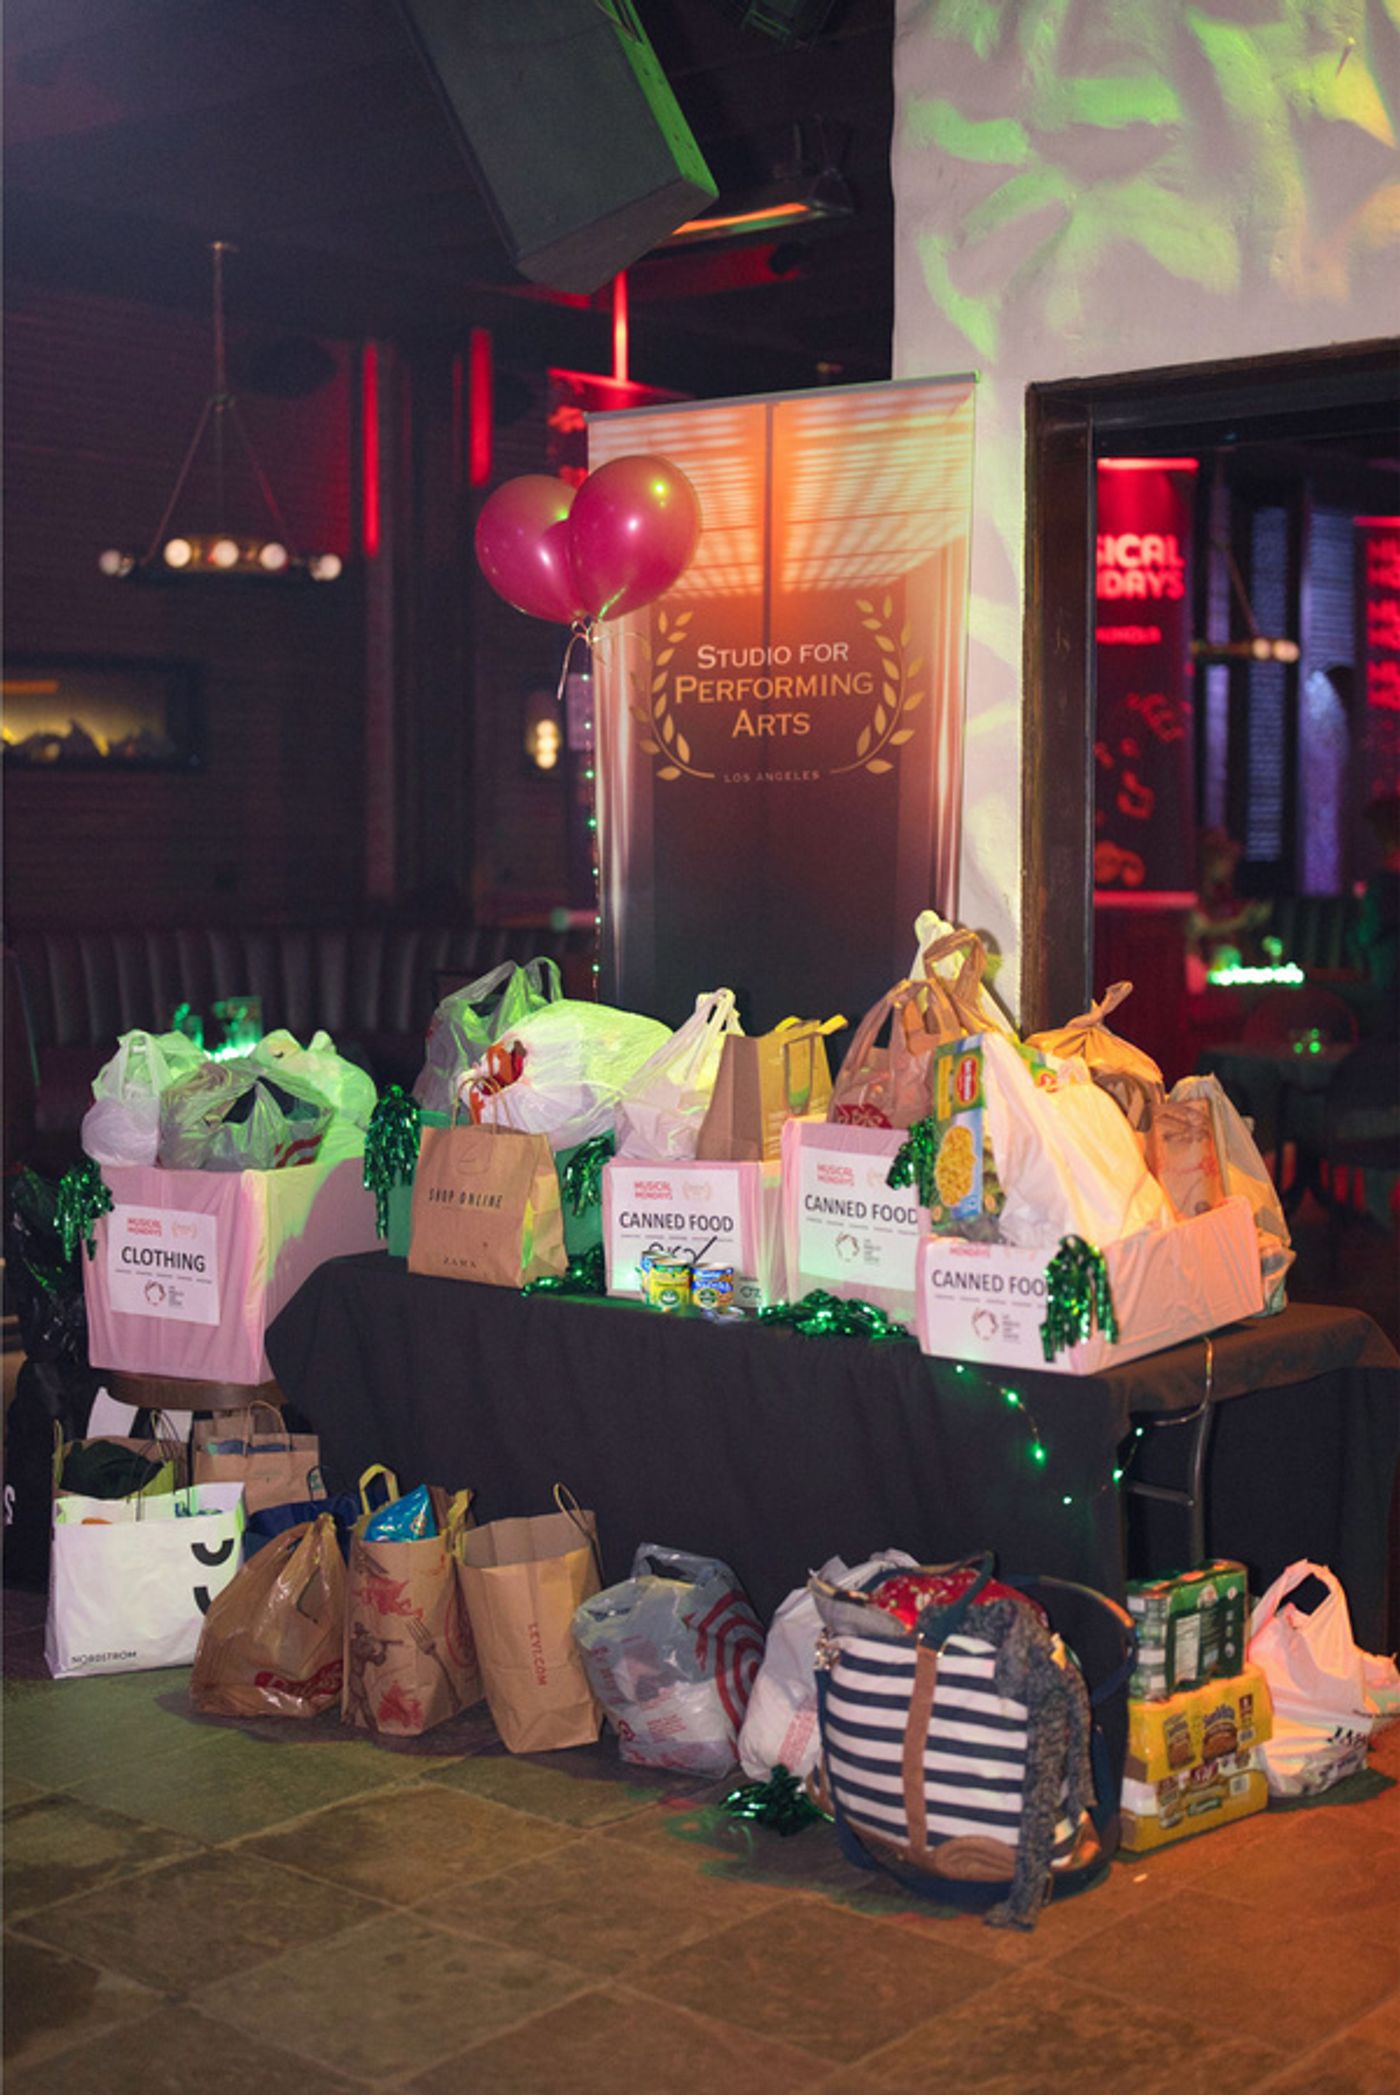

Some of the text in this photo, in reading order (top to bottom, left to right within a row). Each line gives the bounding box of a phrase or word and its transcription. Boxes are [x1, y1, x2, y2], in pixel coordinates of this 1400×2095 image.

[697, 643, 849, 669] STUDIO FOR
[675, 673, 874, 703] PERFORMING
[732, 709, 811, 737] ARTS
[722, 769, 821, 783] LOS ANGELES
[429, 1187, 503, 1209] SHOP ONLINE
[804, 1194, 867, 1219] CANNED
[618, 1210, 735, 1233] CANNED FOOD
[121, 1246, 206, 1273] CLOTHING
[931, 1269, 1047, 1298] CANNED FOO
